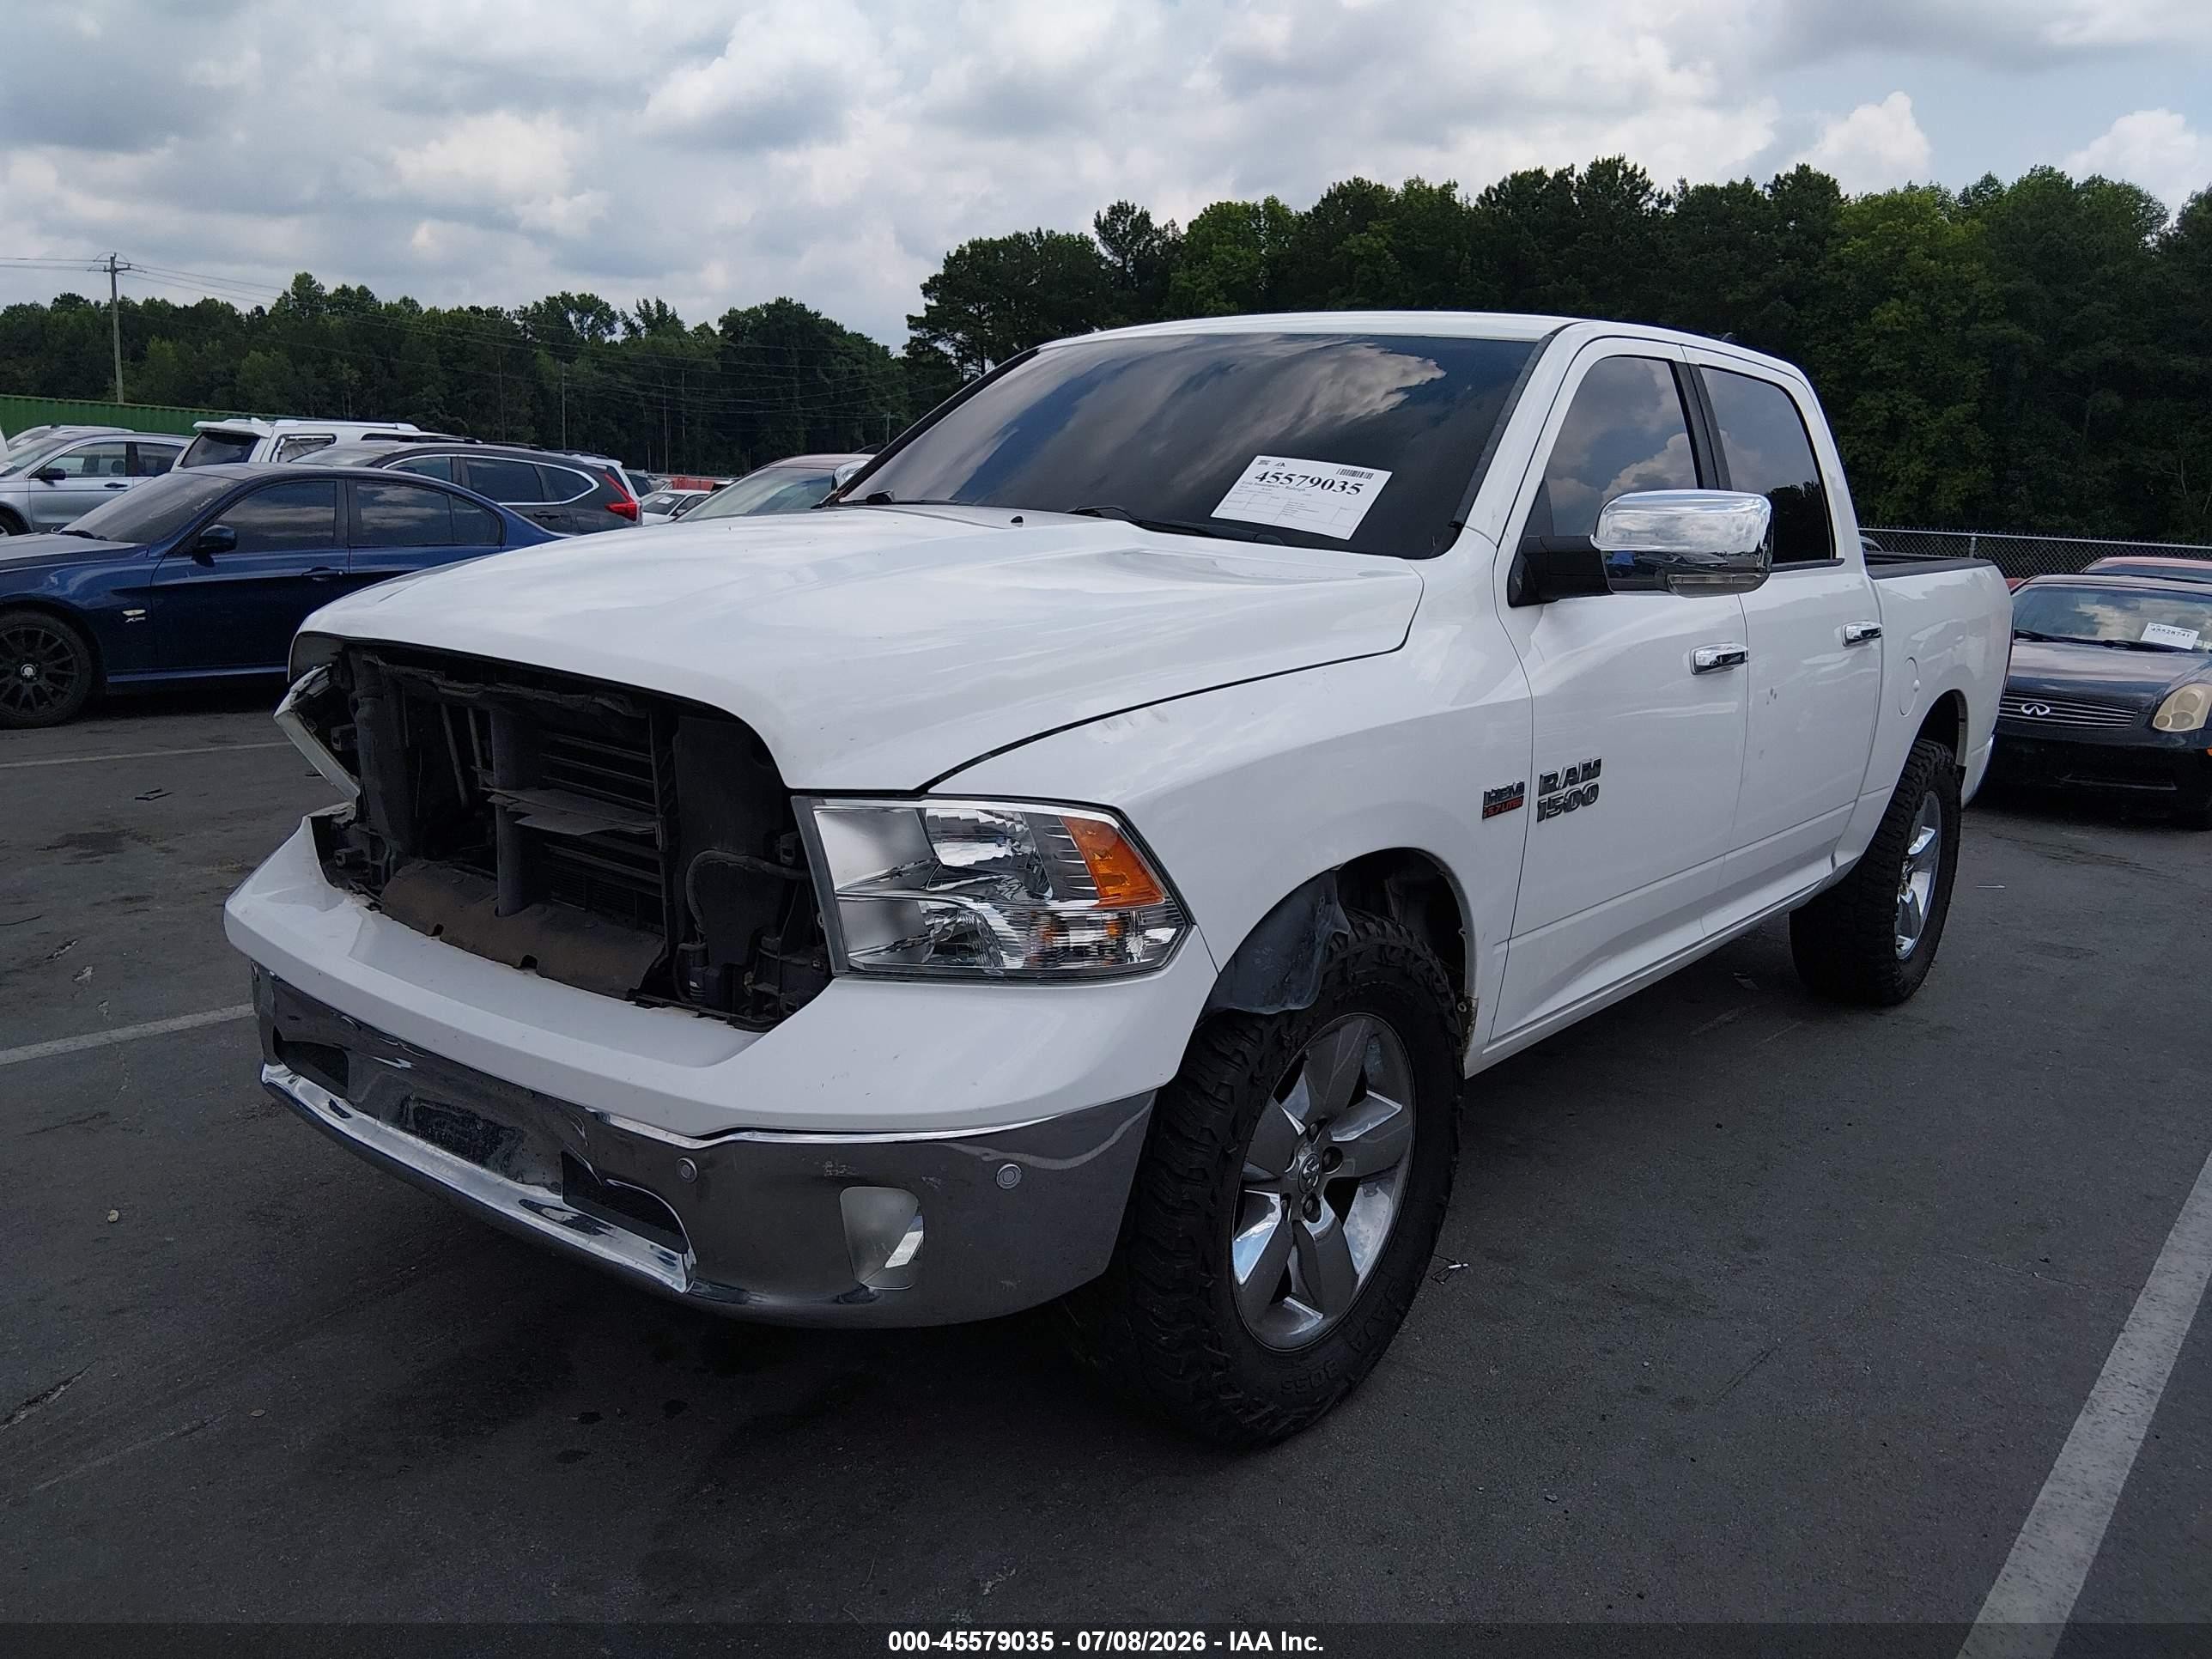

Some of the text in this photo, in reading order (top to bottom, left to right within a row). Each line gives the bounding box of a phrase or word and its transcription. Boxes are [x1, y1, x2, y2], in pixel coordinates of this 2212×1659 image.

[1255, 471, 1364, 495] 45579035
[1538, 757, 1602, 797] RAM
[1537, 782, 1600, 823] 1500
